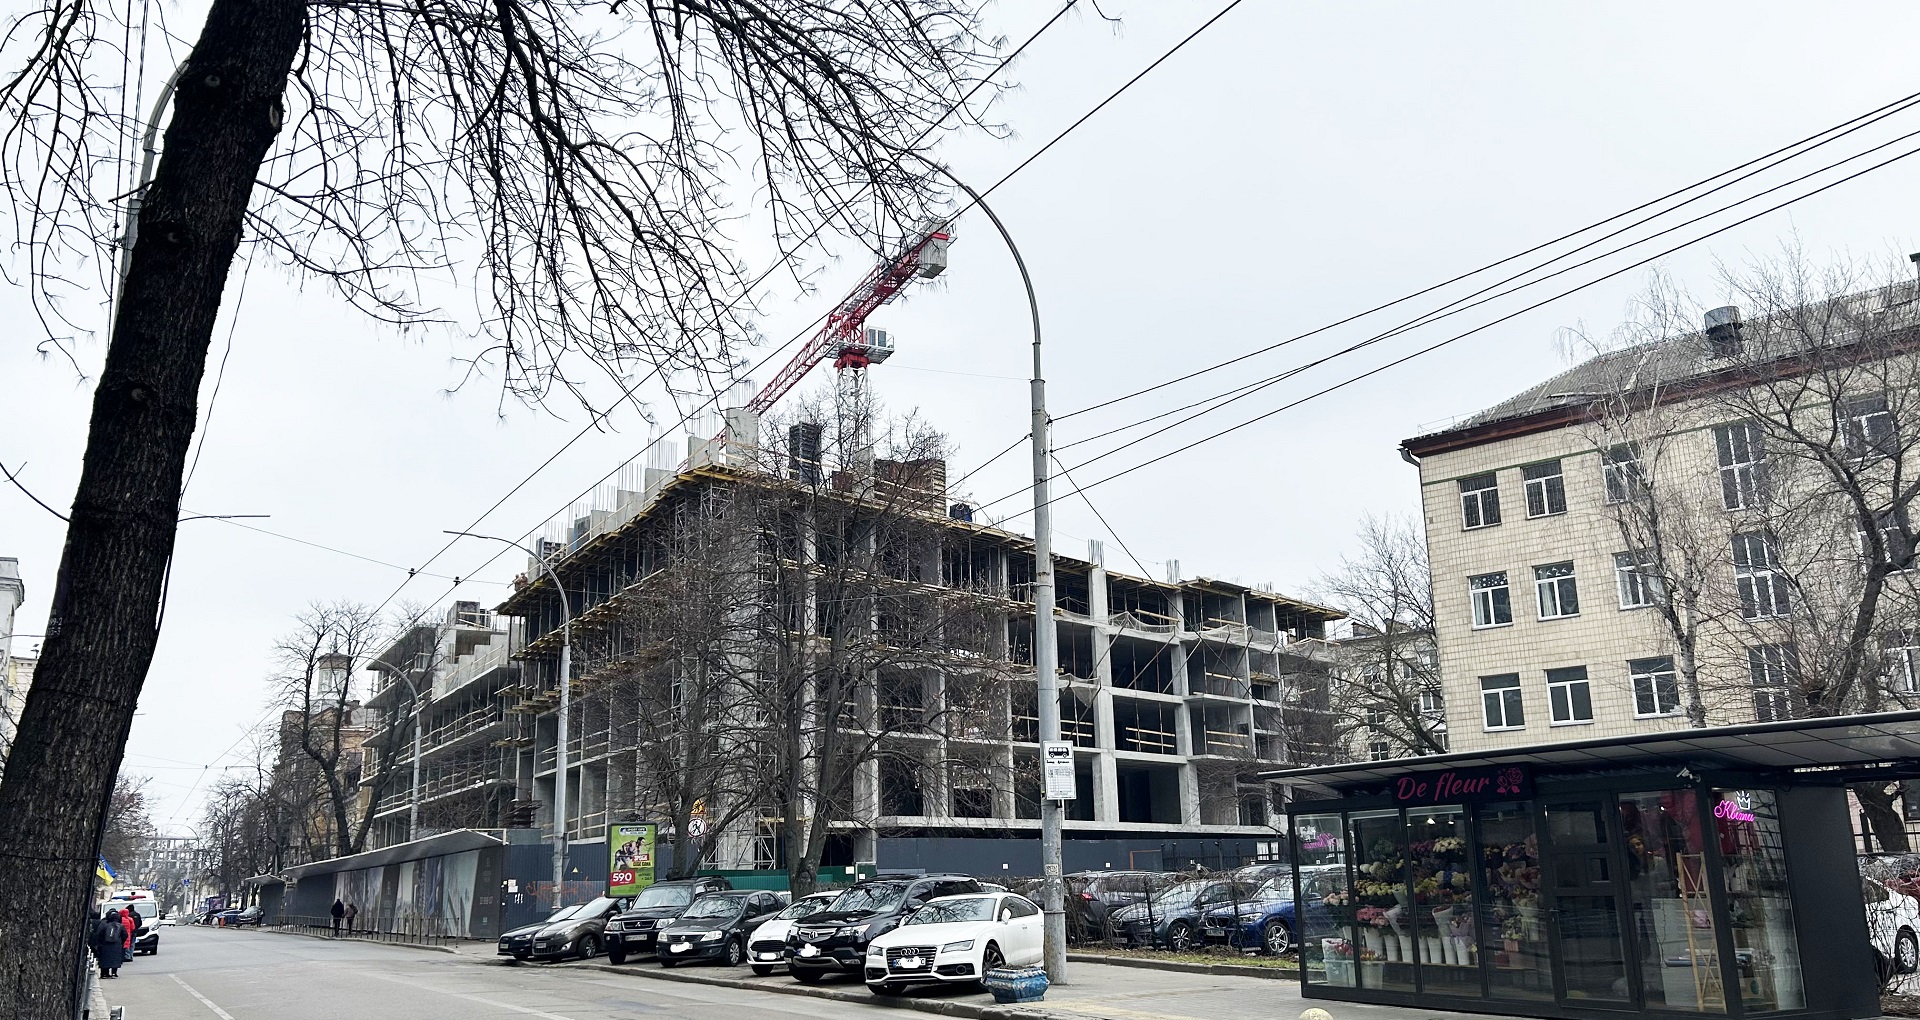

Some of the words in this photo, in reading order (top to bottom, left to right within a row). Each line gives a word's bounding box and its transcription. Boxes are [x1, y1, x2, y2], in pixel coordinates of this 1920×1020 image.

[1397, 777, 1427, 800] De
[1434, 772, 1490, 801] fleur
[613, 872, 632, 882] 590
